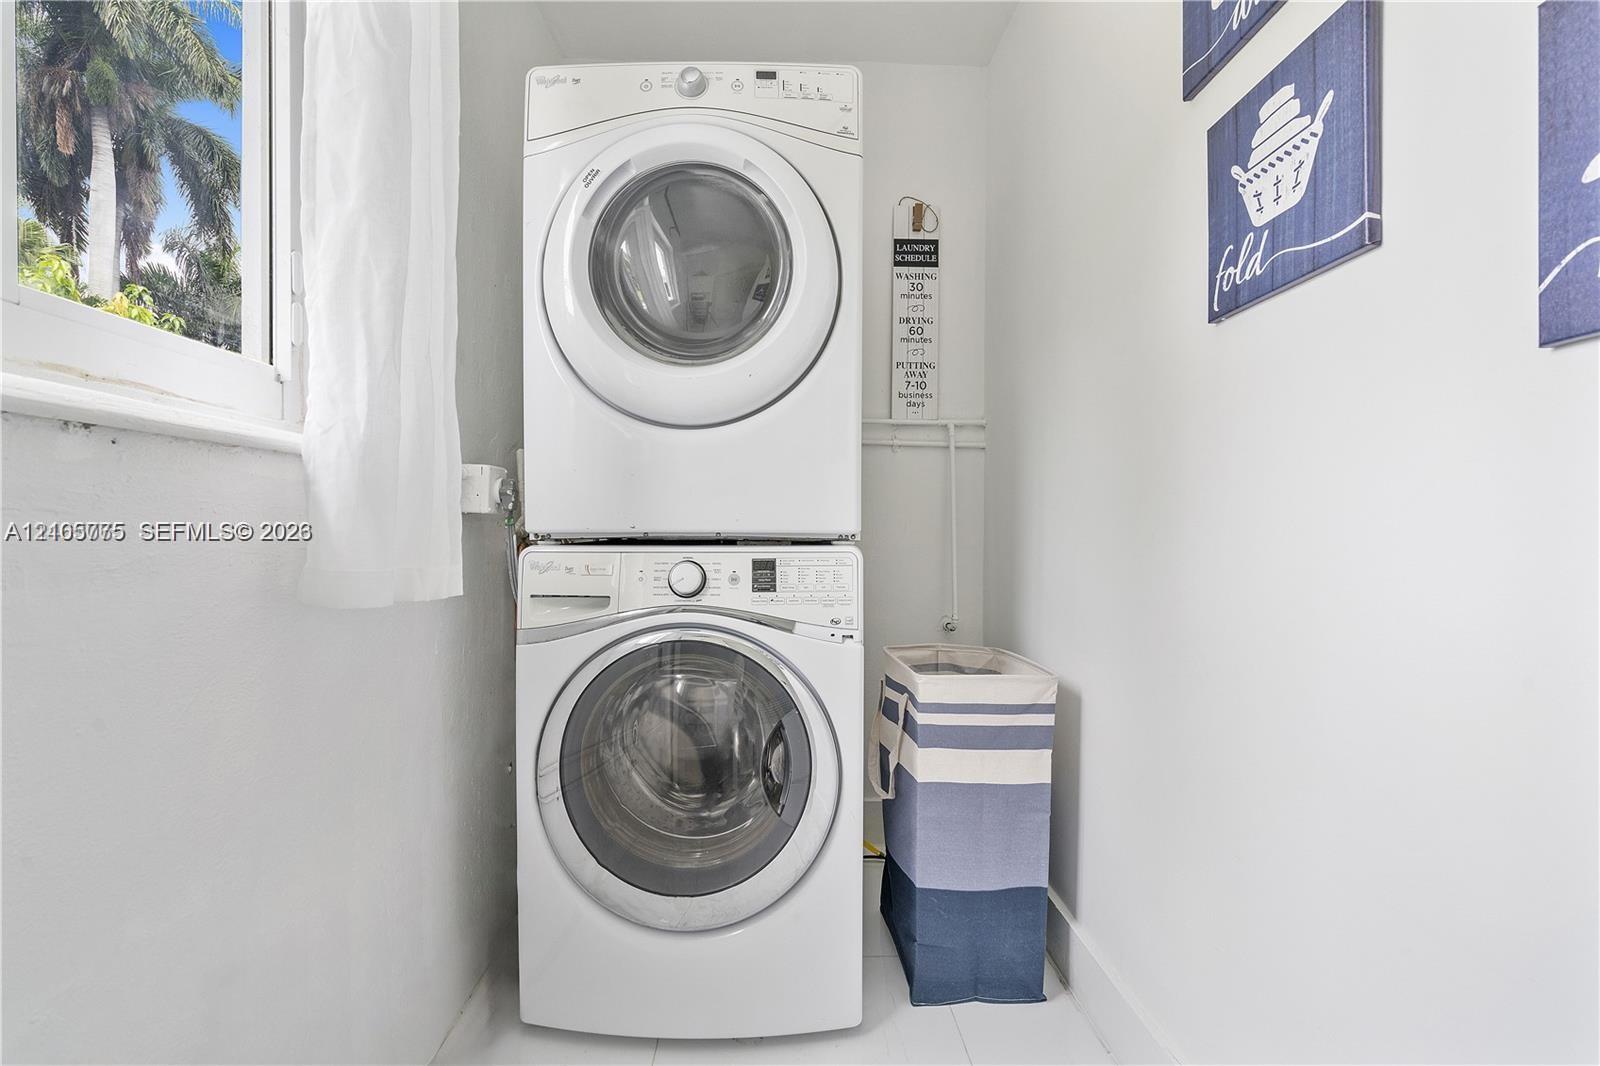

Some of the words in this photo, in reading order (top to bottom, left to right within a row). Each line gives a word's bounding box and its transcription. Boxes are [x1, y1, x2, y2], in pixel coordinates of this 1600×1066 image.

[582, 168, 595, 183] OPEN
[896, 244, 936, 252] LAUNDRY
[895, 254, 938, 262] SCHEDULE
[1213, 229, 1269, 312] fold
[895, 272, 937, 281] WASHING
[909, 282, 924, 292] 30
[900, 292, 933, 300] minutes
[899, 316, 934, 325] DRYING
[908, 326, 924, 336] 60
[900, 336, 933, 344] minutes
[896, 361, 936, 370] PUTTING
[904, 370, 928, 379] AWAY
[905, 380, 927, 391] 7-10
[898, 391, 933, 399] business
[906, 400, 926, 409] days
